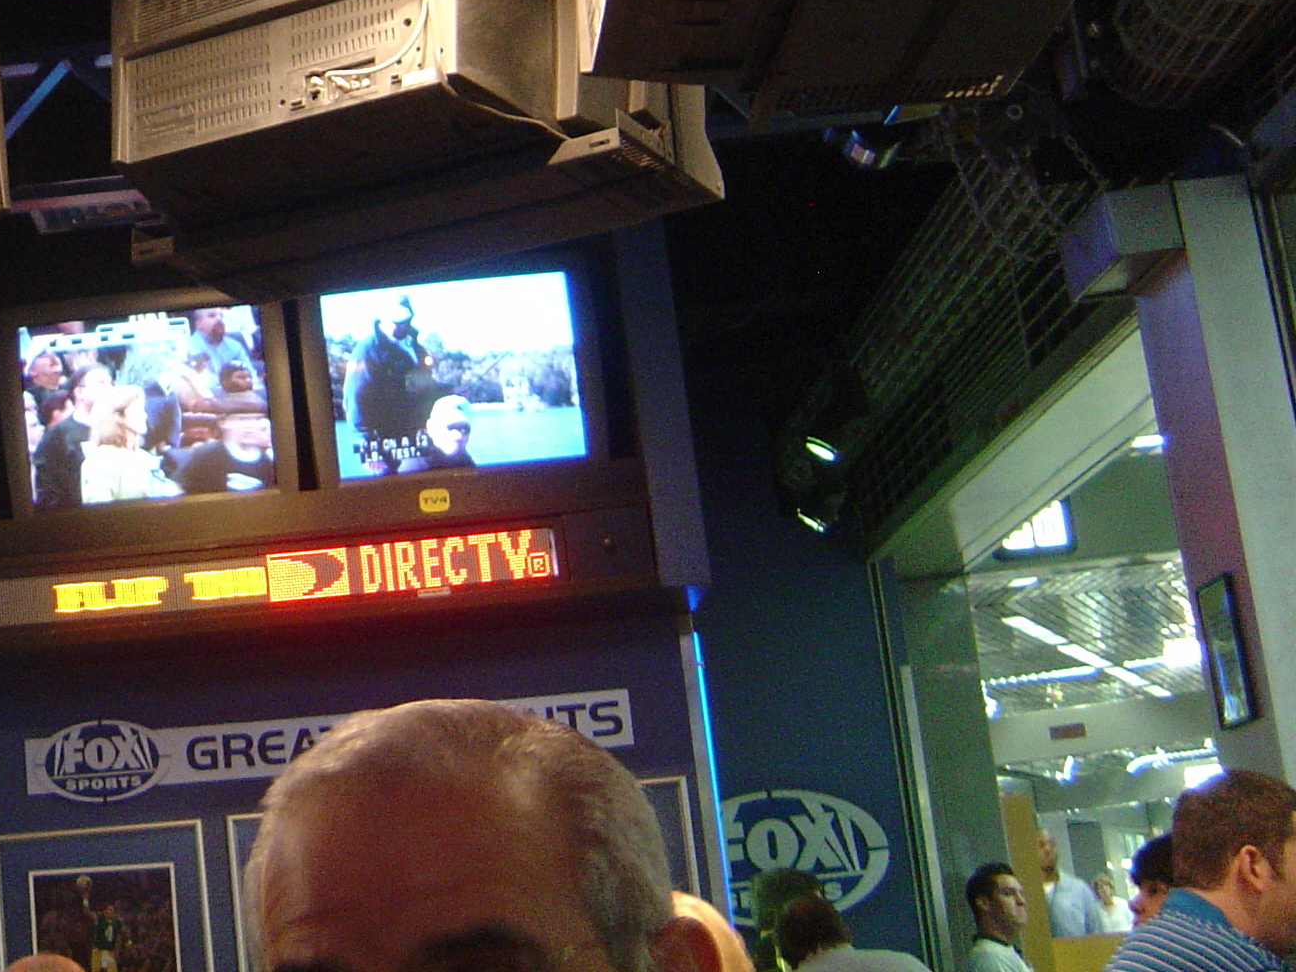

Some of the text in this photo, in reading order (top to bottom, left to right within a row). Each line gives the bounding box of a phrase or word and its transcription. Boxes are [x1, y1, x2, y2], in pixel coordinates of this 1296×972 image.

[422, 495, 448, 506] TV4
[61, 734, 142, 774] FOX
[66, 775, 143, 792] SPORTS
